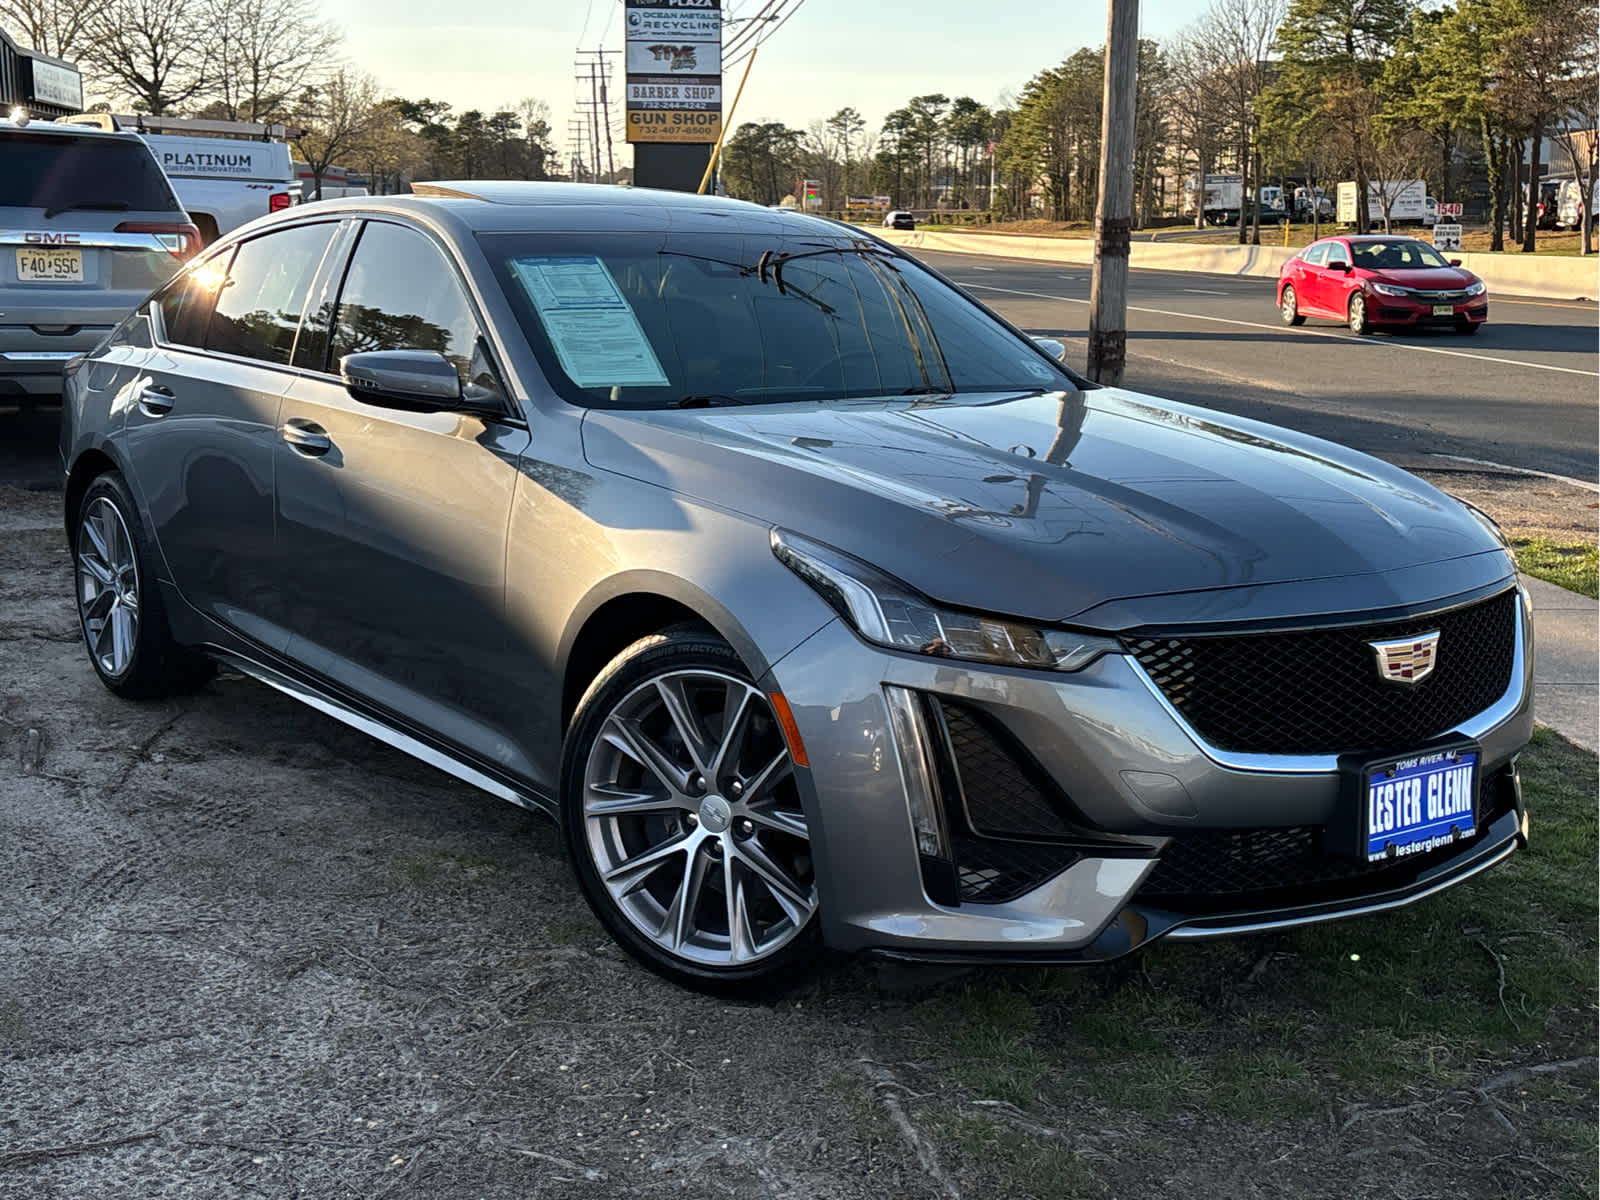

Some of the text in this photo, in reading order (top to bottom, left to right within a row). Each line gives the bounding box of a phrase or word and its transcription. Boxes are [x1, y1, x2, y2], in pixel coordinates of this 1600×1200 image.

[642, 11, 720, 20] OCEAN METALS
[643, 21, 720, 30] RECYCLING
[632, 86, 716, 99] BARBER SHOP
[630, 112, 719, 125] GUN SHOP
[164, 153, 252, 167] PLATINUM
[196, 165, 252, 173] RENOVATIONS
[1436, 203, 1461, 215] 1540
[24, 232, 80, 244] GMC
[21, 257, 79, 273] F40 SSC
[1395, 757, 1418, 771] TOMS
[1445, 750, 1457, 761] NJ
[1369, 766, 1473, 835] LESTER GLENN
